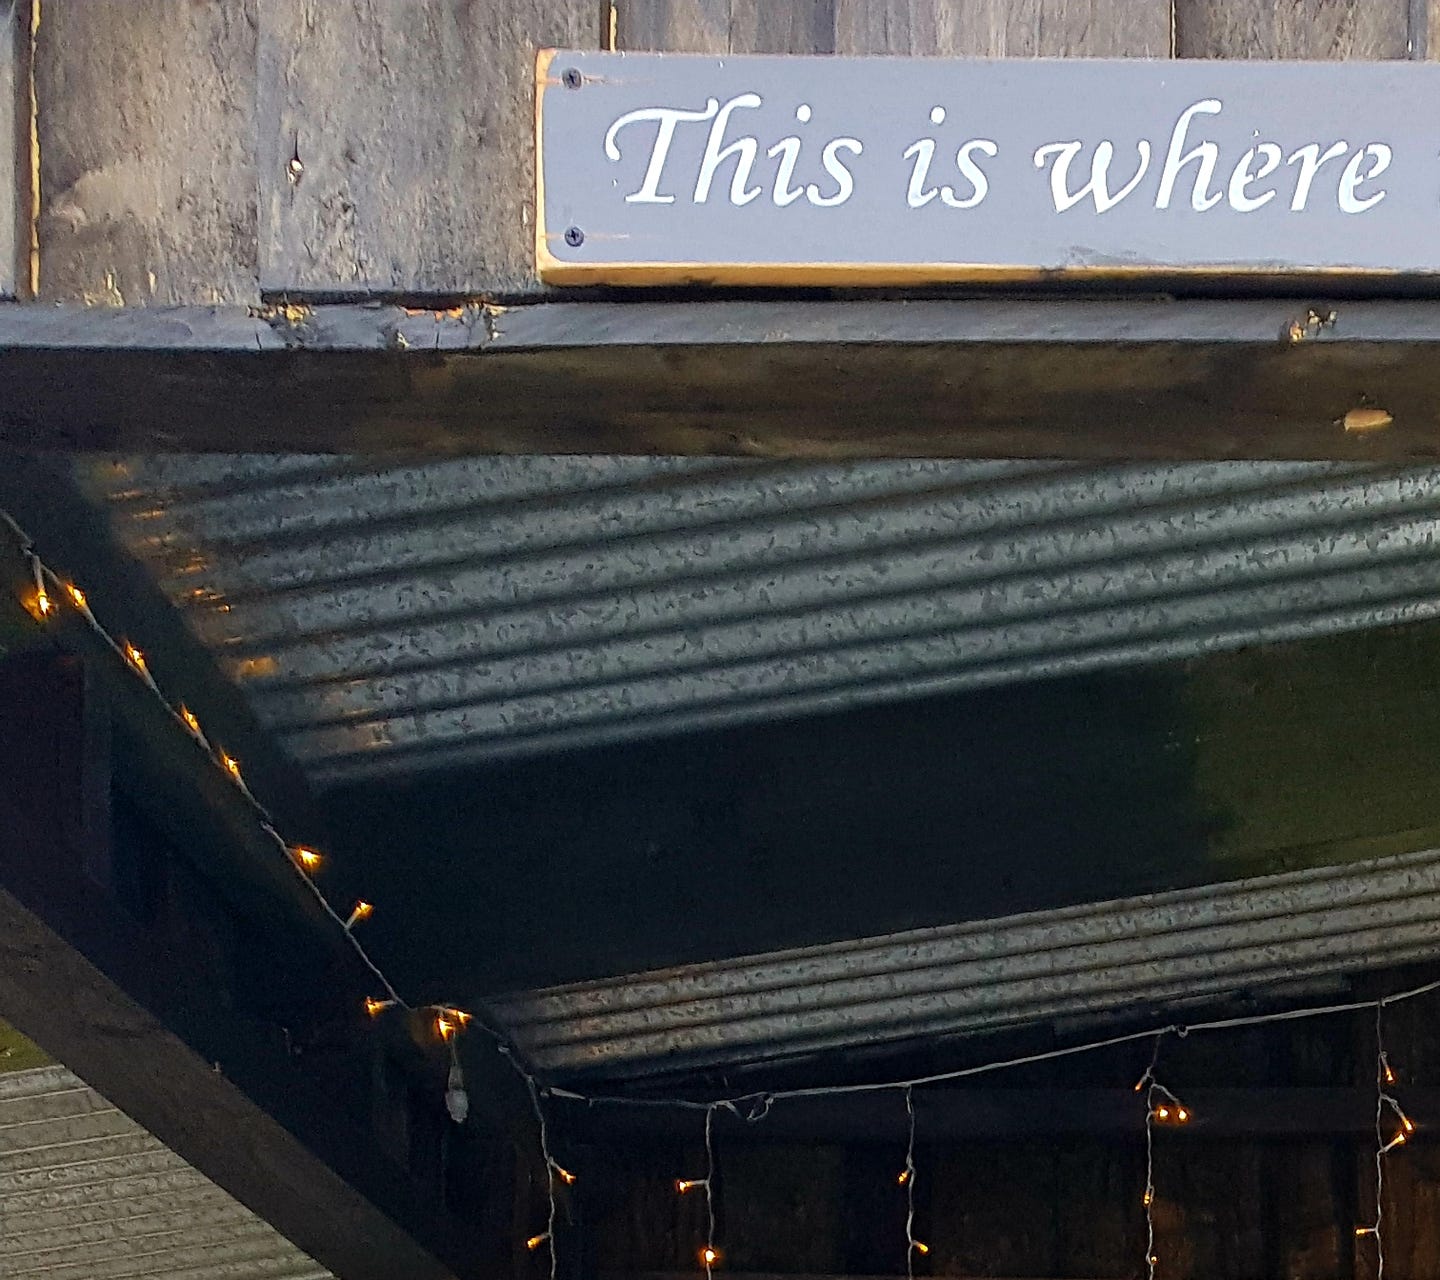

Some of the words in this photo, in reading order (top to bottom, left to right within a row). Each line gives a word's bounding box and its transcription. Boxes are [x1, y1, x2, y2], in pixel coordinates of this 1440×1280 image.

[603, 92, 864, 208] This
[902, 105, 999, 209] is
[1032, 98, 1393, 215] where
